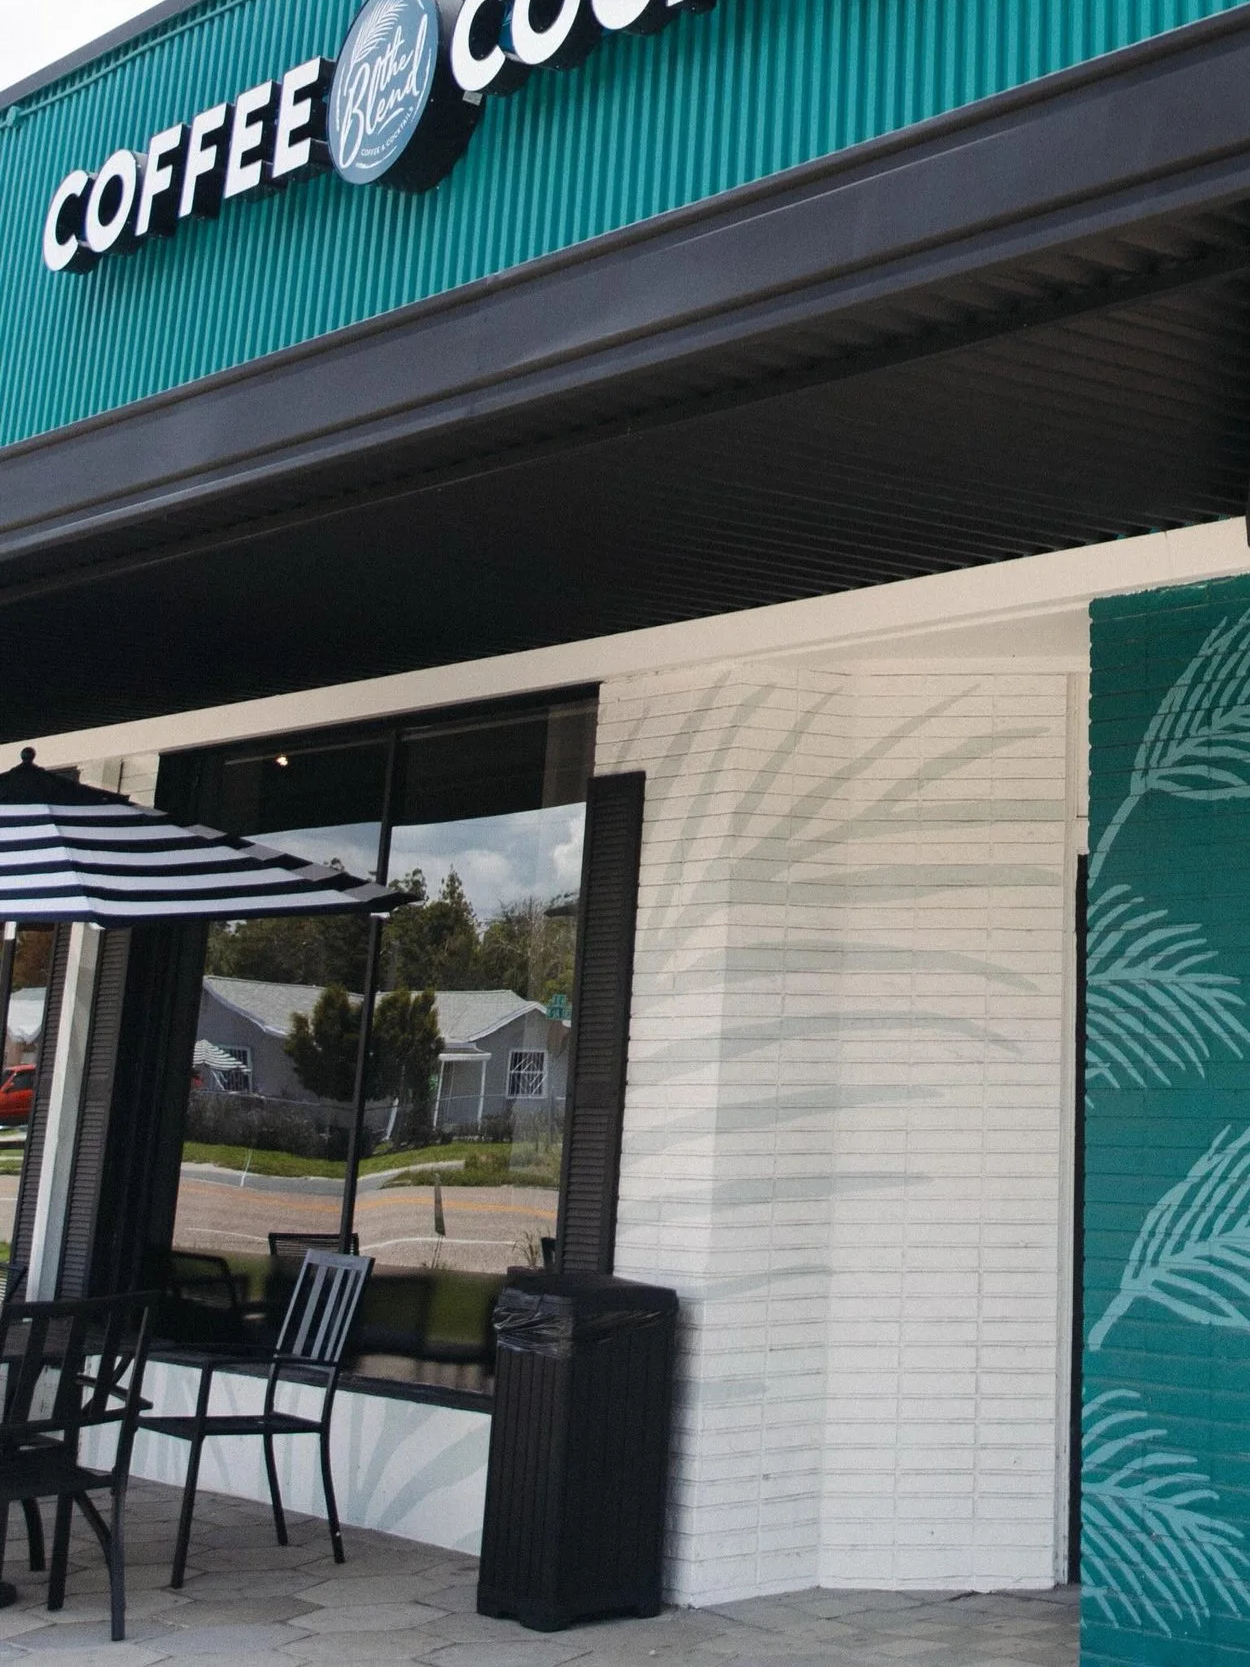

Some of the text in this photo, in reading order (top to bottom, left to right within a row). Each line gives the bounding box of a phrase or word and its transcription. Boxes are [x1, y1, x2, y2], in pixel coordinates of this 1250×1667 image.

[339, 14, 428, 169] Blend
[379, 25, 413, 91] the
[43, 56, 321, 271] COFFEE
